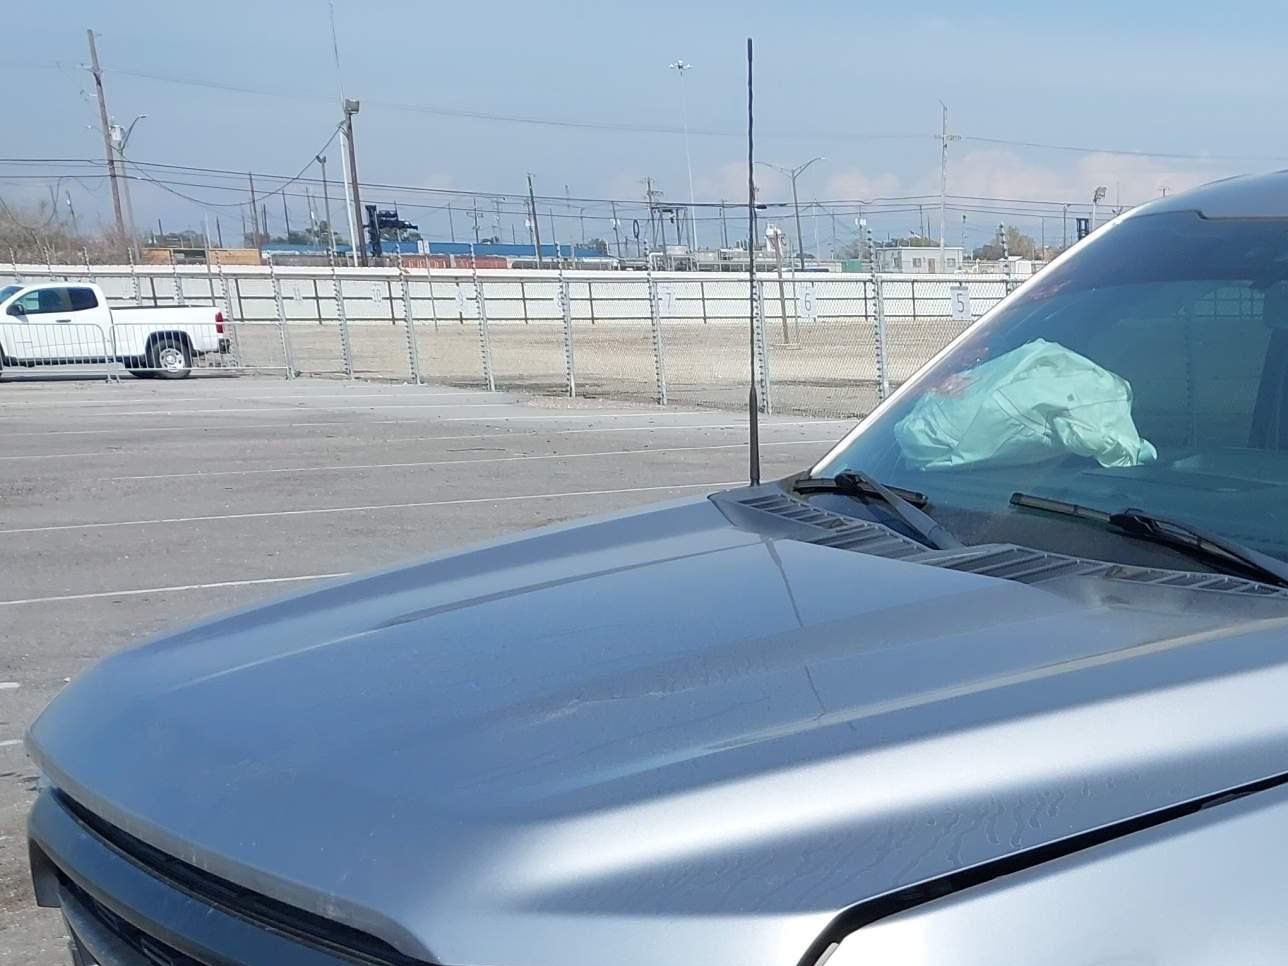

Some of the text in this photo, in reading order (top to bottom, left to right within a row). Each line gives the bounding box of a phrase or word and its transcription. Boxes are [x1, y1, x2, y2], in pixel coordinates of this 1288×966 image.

[661, 291, 673, 311] 7
[804, 292, 813, 311] 6
[956, 293, 965, 312] 5
